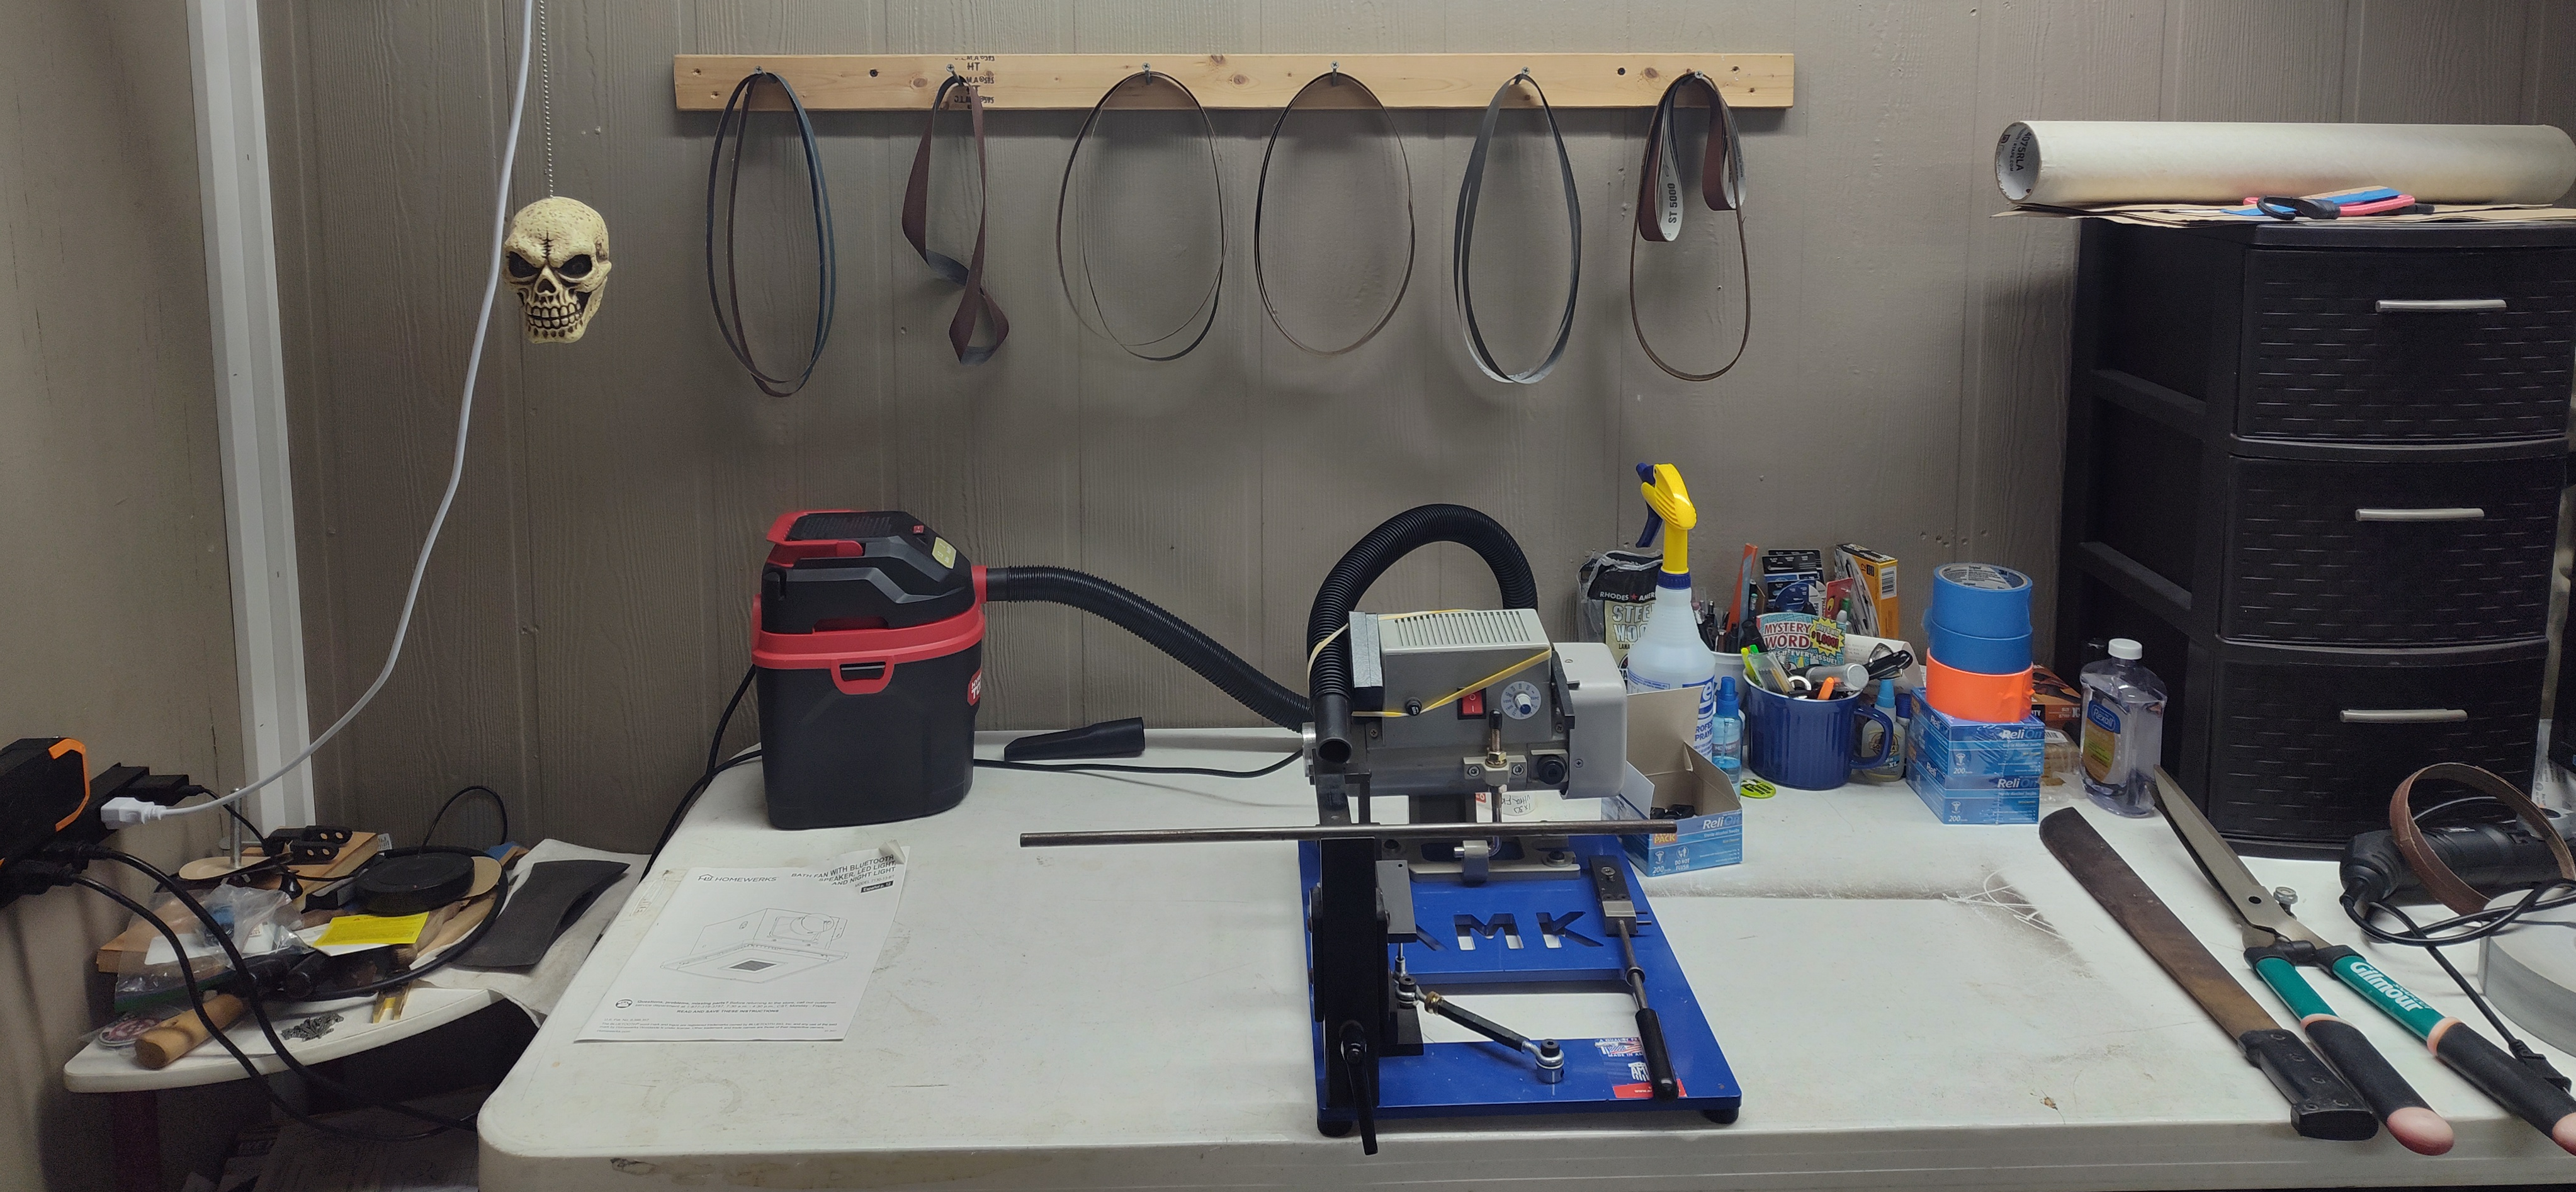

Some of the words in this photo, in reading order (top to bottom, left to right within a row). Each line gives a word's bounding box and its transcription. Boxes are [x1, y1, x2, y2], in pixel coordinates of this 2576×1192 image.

[967, 62, 980, 71] HT
[1668, 183, 1677, 208] 5000
[1669, 211, 1677, 224] ST
[1600, 592, 1629, 601] RHODES
[1613, 623, 1647, 642] WOO
[1764, 622, 1812, 635] MYSTERY
[1765, 635, 1811, 649] WORD
[1816, 654, 1838, 665] ISSUE!
[2093, 708, 2114, 727] Rexall
[2001, 729, 2042, 739] ReliOn
[1997, 778, 2037, 788] ReliOn
[1703, 816, 1740, 830] ReliOn
[1654, 834, 1675, 844] PACK
[818, 871, 856, 882] SPEAKER,
[857, 866, 871, 875] LED
[873, 860, 896, 870] LIGHT,
[830, 866, 848, 876] WITH
[850, 854, 894, 871] BLUETOOTH
[850, 872, 873, 883] NIGHT
[873, 866, 896, 876] LIGHT
[2350, 962, 2424, 1012] Gilmour
